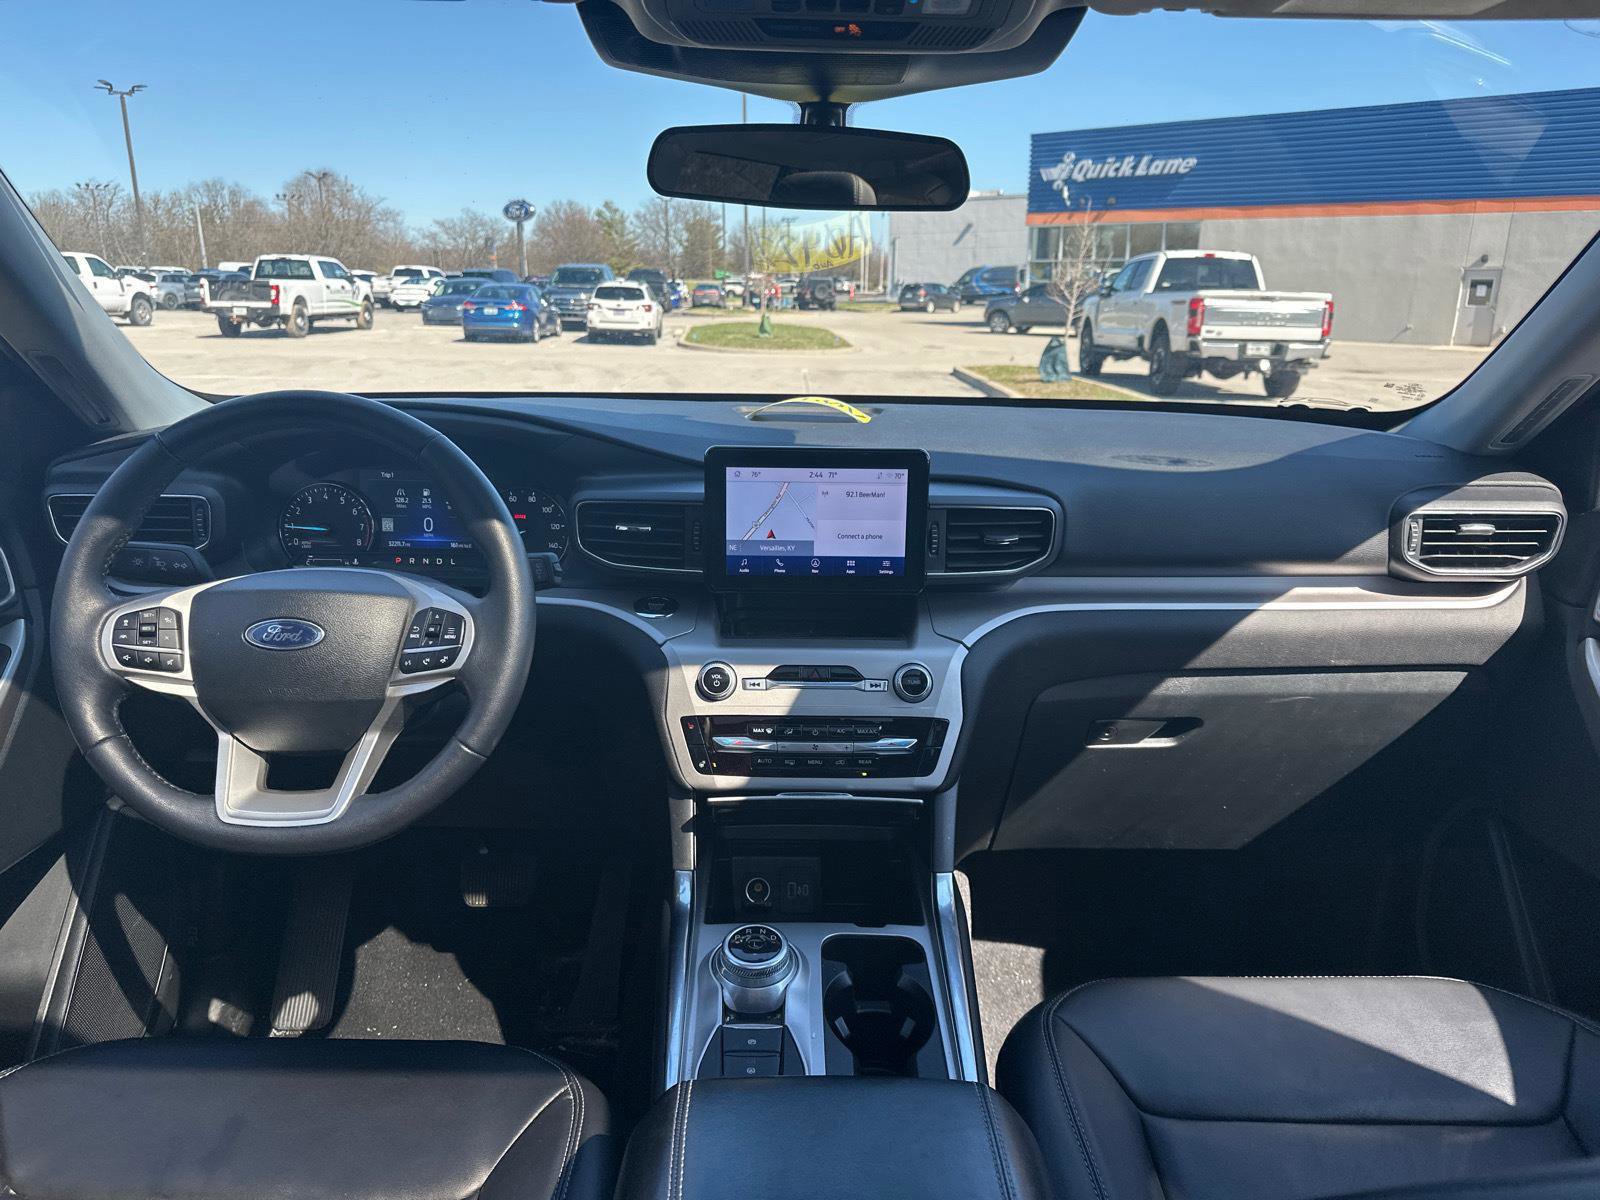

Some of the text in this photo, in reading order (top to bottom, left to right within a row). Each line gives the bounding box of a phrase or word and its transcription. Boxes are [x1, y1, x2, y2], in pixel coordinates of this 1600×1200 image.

[1071, 154, 1198, 182] Quick Lane
[380, 471, 391, 479] Trip
[308, 496, 312, 504] 3
[296, 507, 301, 515] 2
[352, 507, 358, 516] 6
[359, 523, 364, 531] 7
[423, 517, 434, 532] 0
[837, 532, 861, 540] Connect
[865, 533, 883, 541] phone
[293, 538, 299, 546] 0
[262, 624, 304, 641] Ford
